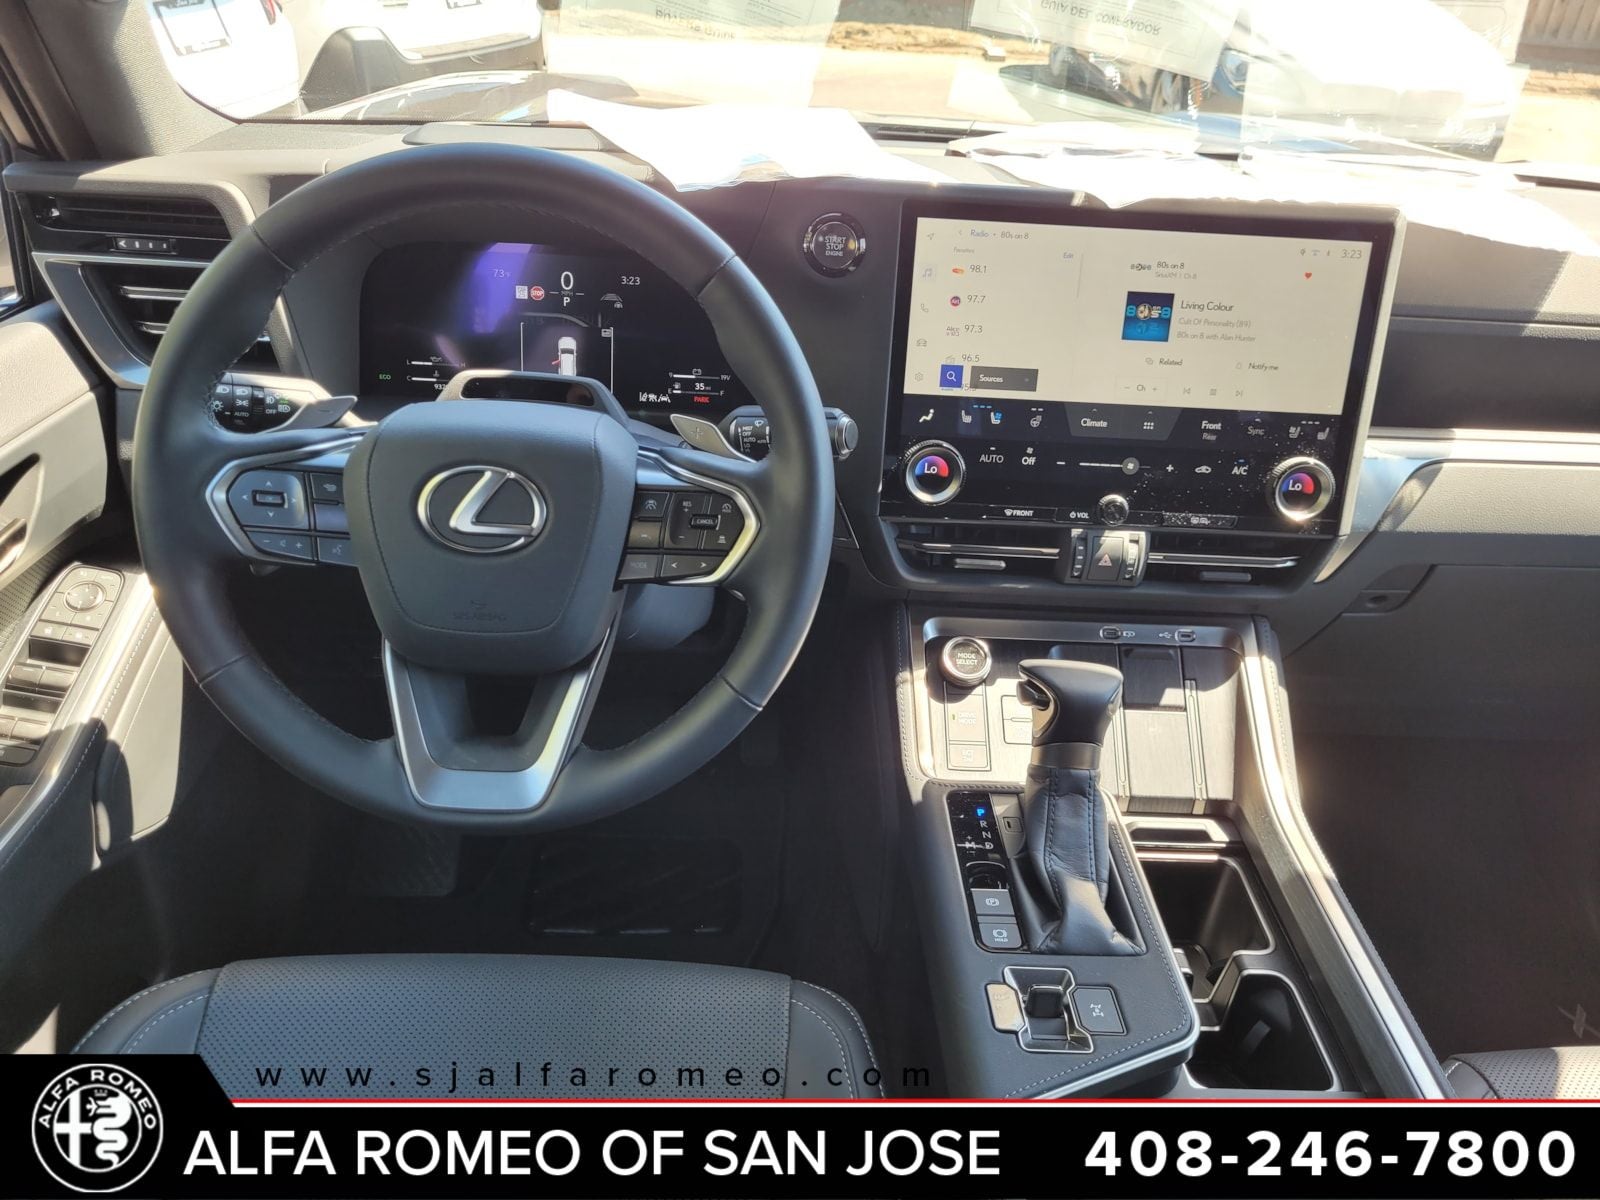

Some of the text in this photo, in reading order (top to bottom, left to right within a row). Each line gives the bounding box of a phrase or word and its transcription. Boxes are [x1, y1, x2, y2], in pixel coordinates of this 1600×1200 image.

[970, 229, 989, 238] Radio
[825, 235, 846, 244] START
[1341, 249, 1362, 259] 3:23
[969, 264, 987, 273] 98.1
[1156, 261, 1169, 269] 80s
[560, 271, 574, 291] 0
[621, 275, 641, 286] 3:23
[563, 296, 571, 307] P
[966, 294, 986, 304] 97.7
[1181, 301, 1234, 312] Living Colour
[1203, 319, 1235, 329] Personality
[964, 324, 983, 334] 97.3
[961, 353, 980, 363] 96.5
[1159, 358, 1183, 366] Related
[1248, 362, 1267, 371] Notify
[979, 374, 1004, 383] Sources
[694, 382, 705, 391] 35
[1136, 384, 1146, 392] Ch
[1080, 418, 1108, 428] Climate
[1201, 421, 1222, 430] Front
[1247, 426, 1265, 436] Sync
[1202, 433, 1217, 441] Rear
[979, 454, 1004, 464] AUTO
[1021, 456, 1037, 466] Off
[924, 463, 938, 474] Lo
[1232, 466, 1248, 475] A/C
[1288, 480, 1302, 491] Lo
[630, 561, 647, 569] MODE
[955, 658, 978, 666] SELECT
[976, 808, 985, 817] P
[979, 820, 988, 829] R
[982, 831, 992, 839] N
